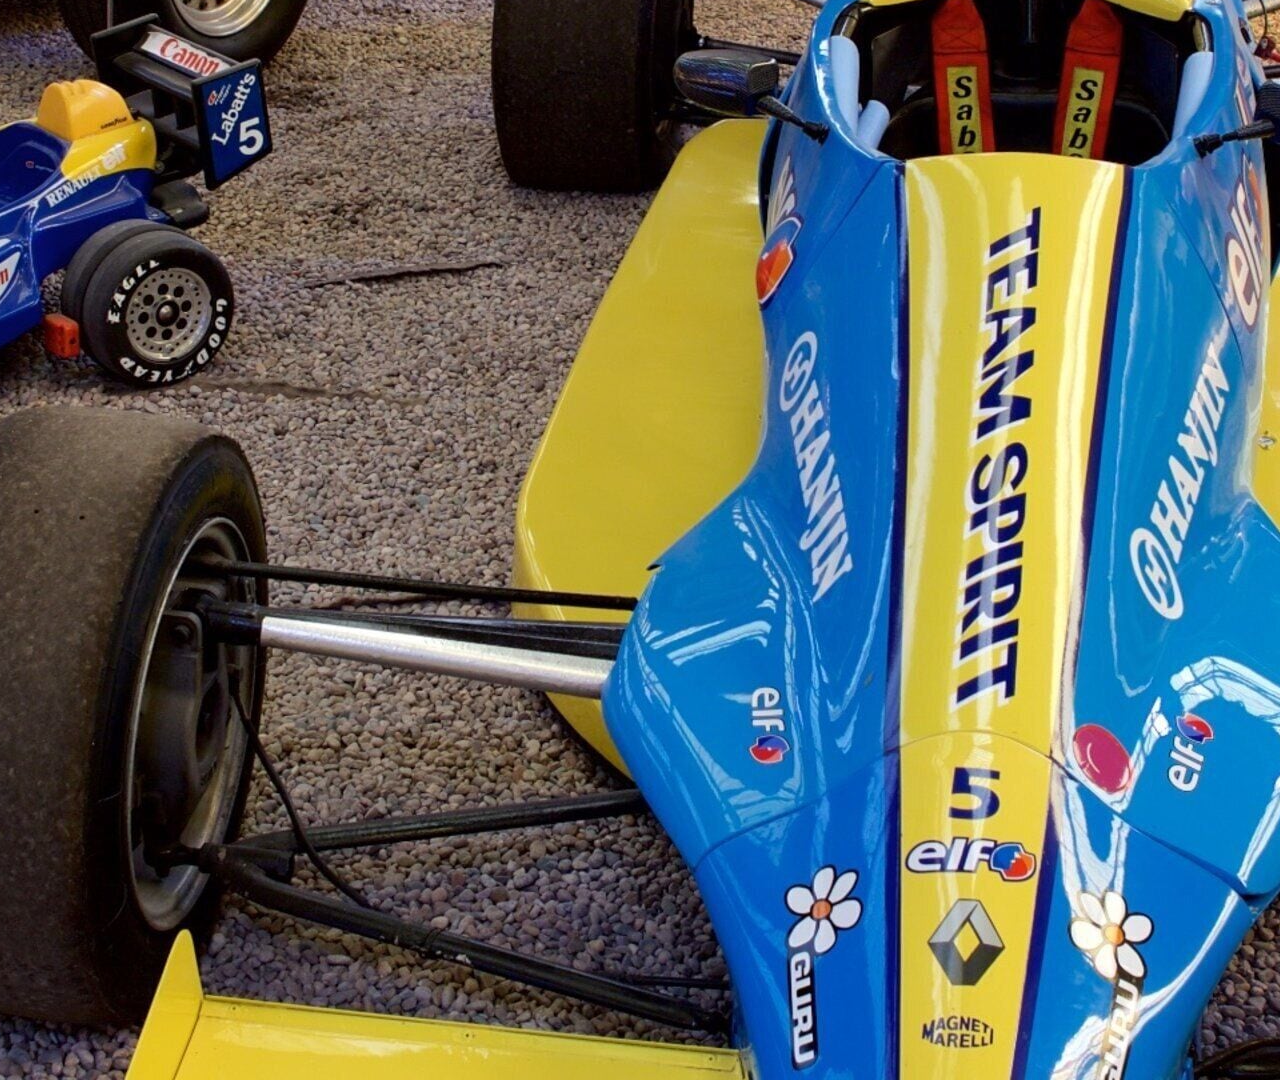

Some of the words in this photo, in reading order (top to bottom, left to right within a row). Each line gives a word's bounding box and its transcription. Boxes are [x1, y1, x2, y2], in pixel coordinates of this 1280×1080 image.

[160, 37, 221, 77] Canon
[211, 72, 256, 147] Labatt's
[238, 116, 264, 156] 5
[951, 75, 977, 154] Sab
[1067, 79, 1099, 159] Sab
[45, 164, 103, 209] RENAULT
[107, 259, 160, 324] EAGLE
[1225, 179, 1264, 332] elf
[975, 206, 1042, 442] TEAM
[1150, 340, 1230, 565] HANJIN
[789, 378, 854, 604] HANJIN
[956, 440, 1029, 708] SPIRIT
[751, 686, 783, 732] elf
[948, 766, 1001, 820] 5
[1167, 734, 1205, 793] elf
[905, 837, 995, 874] elf
[790, 949, 816, 1067] GURU
